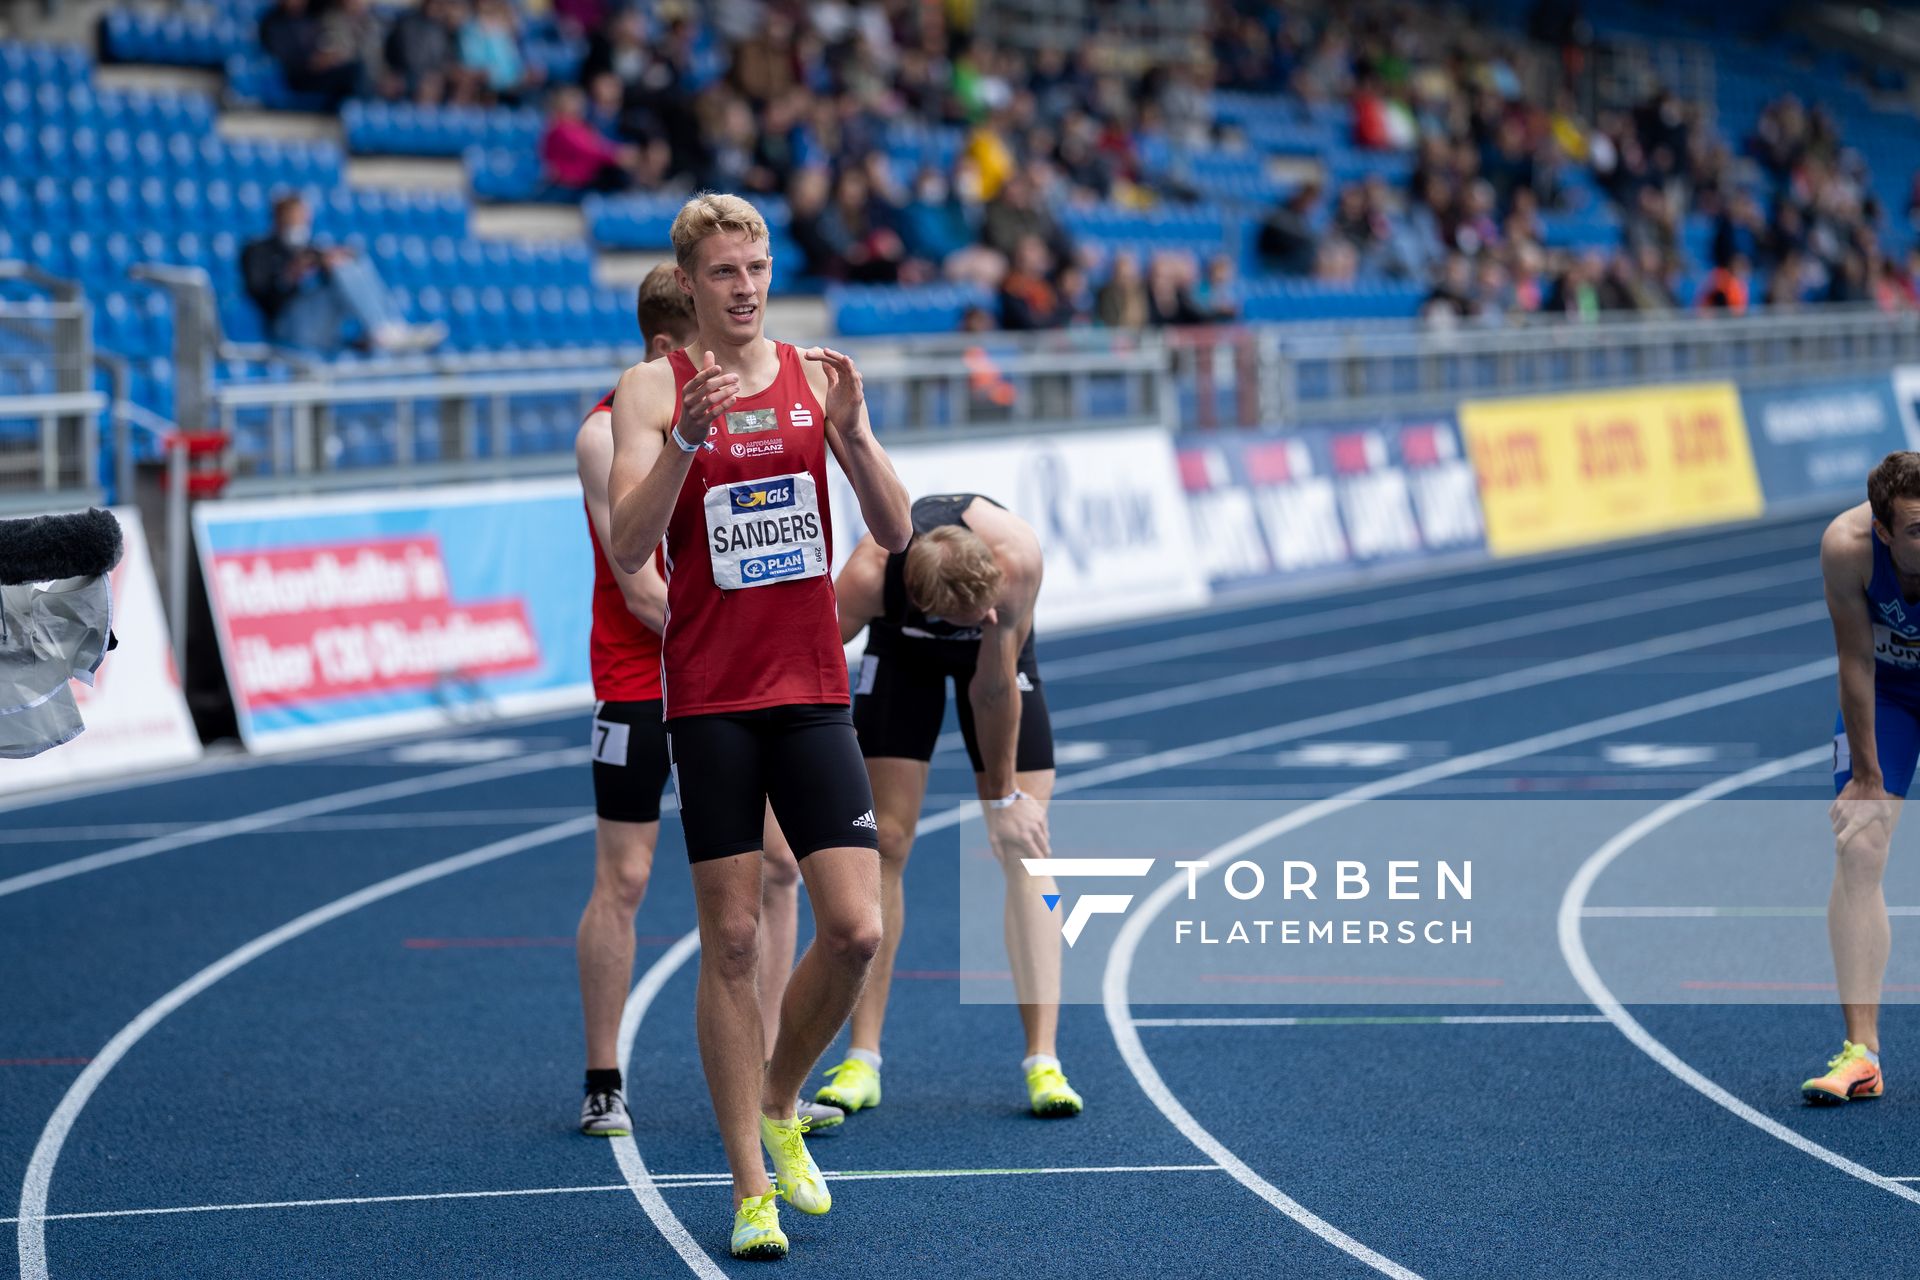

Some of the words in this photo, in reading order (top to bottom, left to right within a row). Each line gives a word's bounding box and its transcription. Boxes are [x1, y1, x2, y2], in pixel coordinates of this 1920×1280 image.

[746, 444, 784, 454] PFLANZ
[767, 487, 789, 504] GLS
[713, 512, 819, 554] SANDERS
[768, 554, 801, 570] PLAN
[597, 725, 610, 758] 7
